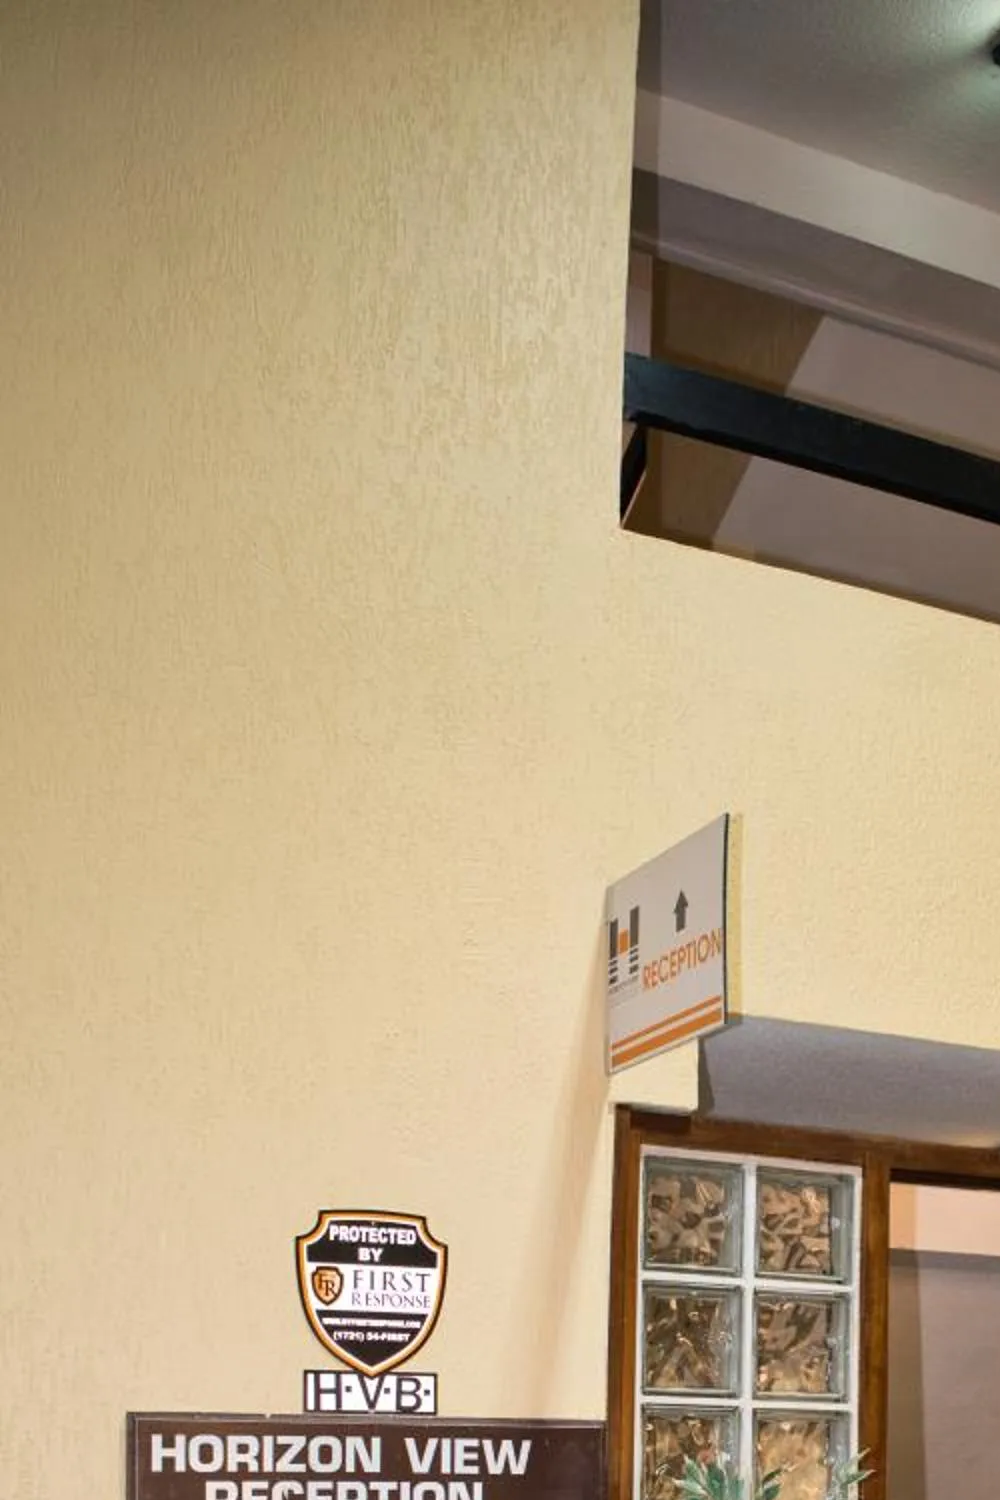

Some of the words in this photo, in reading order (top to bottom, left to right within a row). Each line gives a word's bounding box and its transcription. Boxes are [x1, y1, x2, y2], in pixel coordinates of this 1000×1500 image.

[642, 927, 722, 991] RECEPTION
[329, 1225, 416, 1246] PROTECTED
[357, 1248, 383, 1262] BY
[352, 1269, 431, 1293] FIRST
[351, 1292, 431, 1309] RESPONSE
[151, 1434, 381, 1473] HORIZON
[404, 1437, 532, 1476] VIEW
